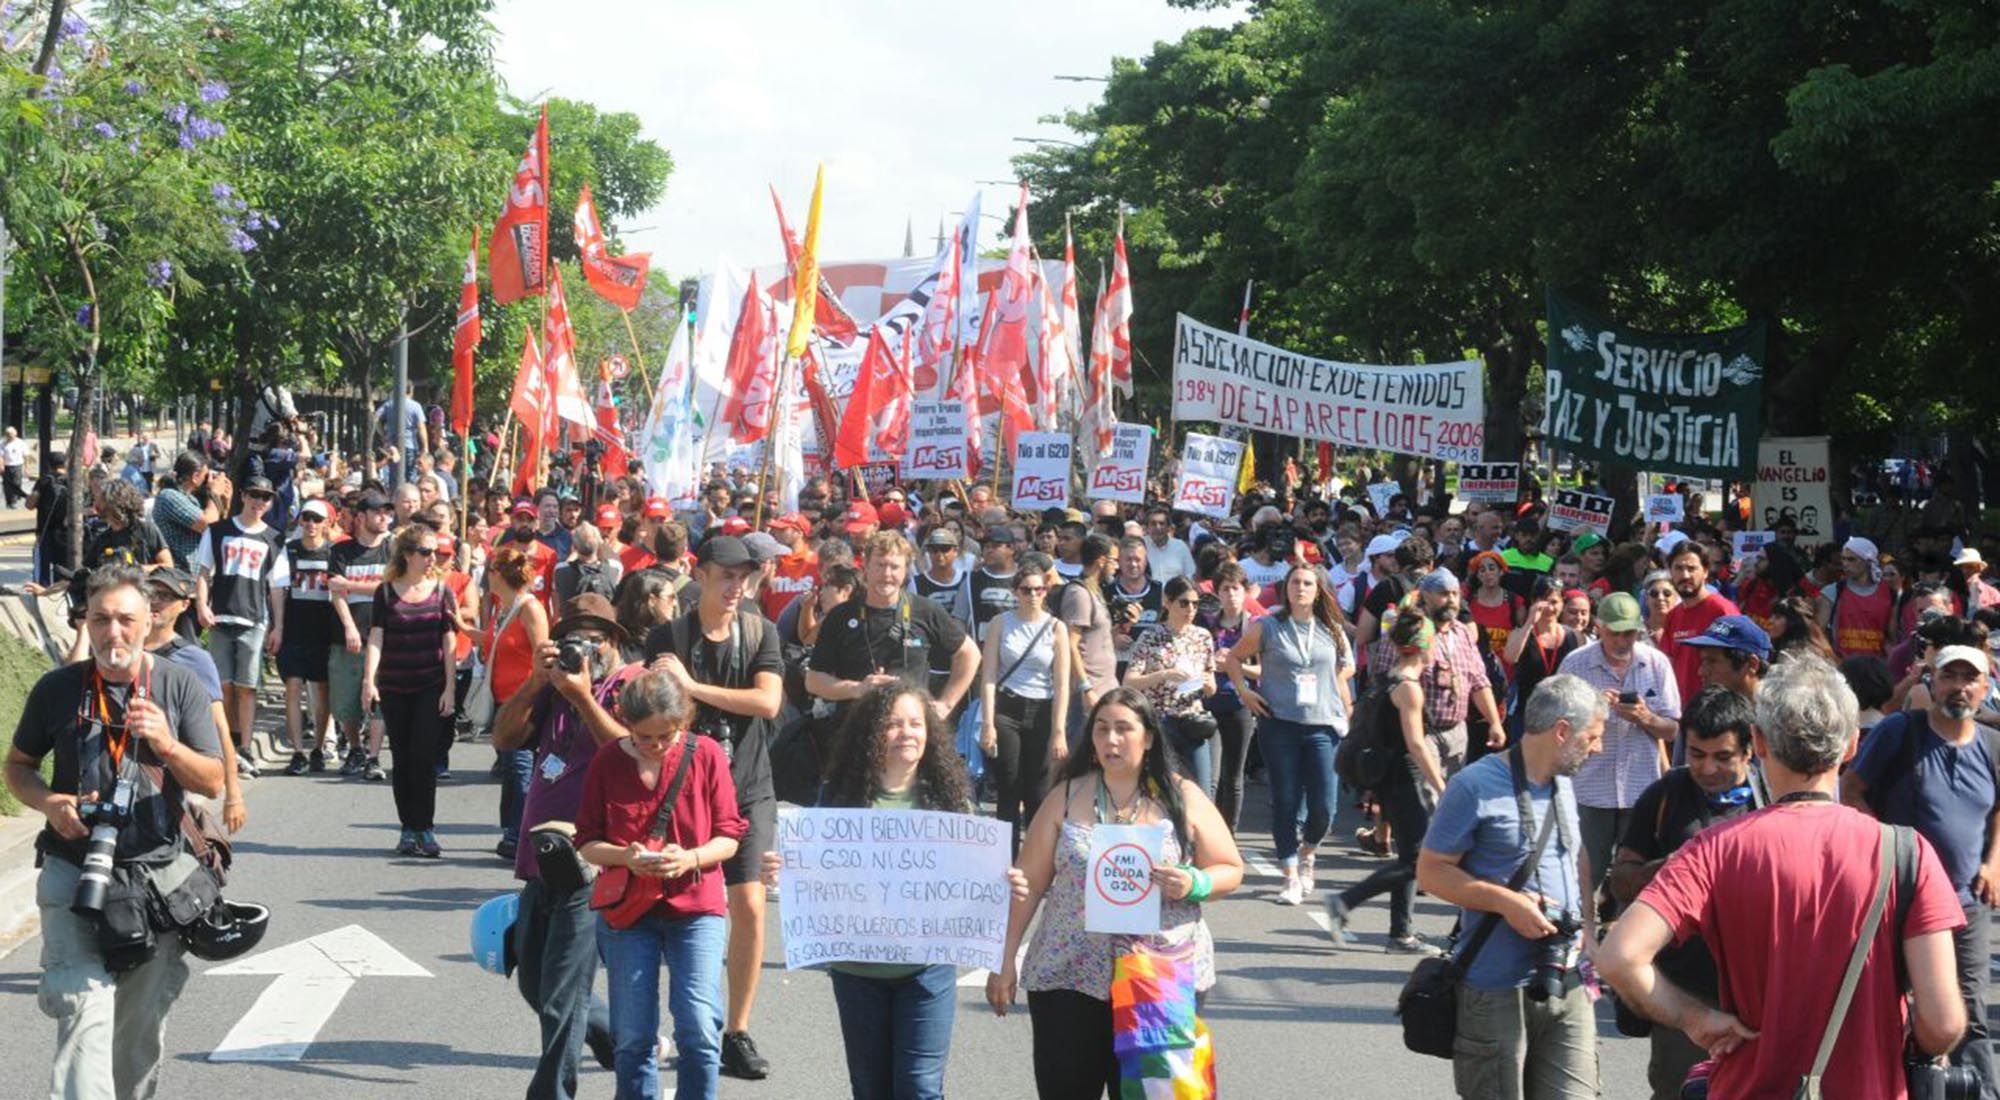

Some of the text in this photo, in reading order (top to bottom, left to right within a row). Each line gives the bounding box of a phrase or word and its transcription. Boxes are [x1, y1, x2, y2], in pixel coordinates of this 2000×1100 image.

[1177, 379, 1216, 403] 1984
[1220, 381, 1434, 454] DESAPARECIDOS
[1437, 420, 1484, 448] 2006
[1540, 369, 1586, 443] PAZ
[1593, 398, 1611, 449] Y
[912, 445, 962, 469] MST
[1018, 443, 1070, 458] No al G20
[1187, 446, 1237, 466] No al G20
[1436, 446, 1480, 463] 2018
[1779, 450, 1797, 465] EL
[1016, 476, 1065, 500] MST
[1093, 465, 1142, 491] MST
[1181, 480, 1228, 508] MST
[1782, 486, 1797, 501] ES
[224, 544, 263, 569] PTS
[820, 815, 864, 841] SON
[871, 815, 1000, 846] BIENVENIDOS
[784, 849, 811, 870] EL
[872, 848, 893, 870] NI
[898, 847, 937, 871] SUS
[1114, 856, 1136, 865] FMI
[1103, 867, 1144, 879] DEUDA
[794, 880, 867, 904] PIRATAS
[878, 879, 891, 904] Y
[1110, 880, 1137, 892] G20
[784, 915, 803, 937] NO
